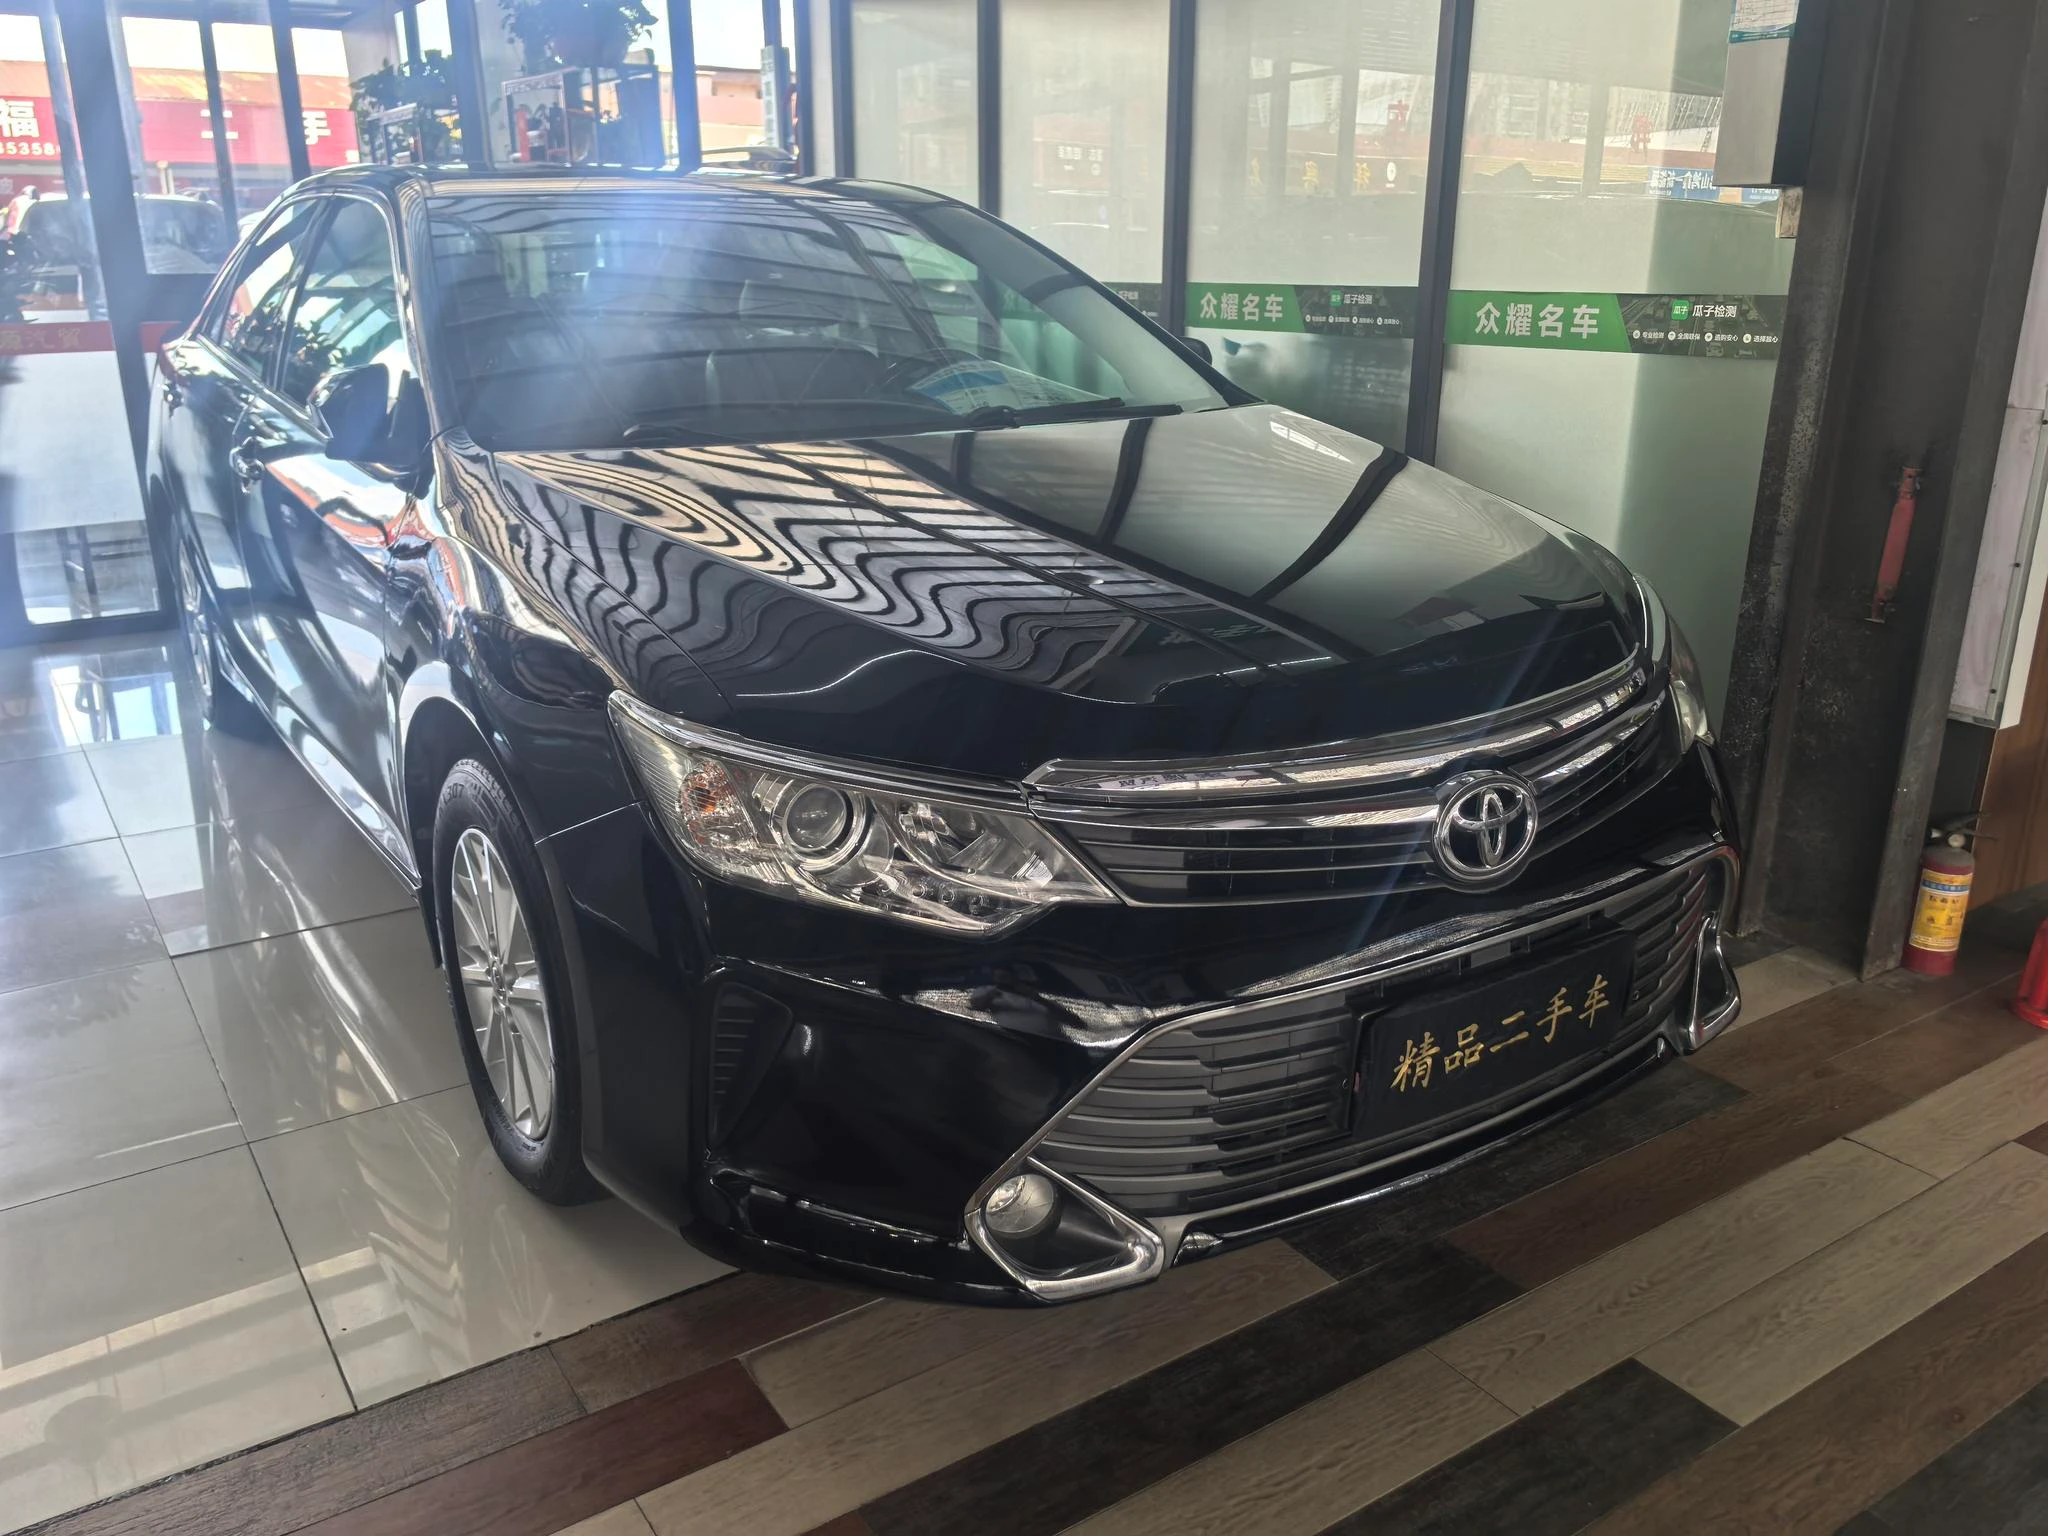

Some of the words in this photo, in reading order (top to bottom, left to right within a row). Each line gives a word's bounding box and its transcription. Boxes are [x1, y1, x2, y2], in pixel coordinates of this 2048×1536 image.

[0, 98, 40, 138] 福
[1200, 291, 1284, 322] 众耀名车
[1474, 301, 1600, 339] 众耀名车
[1673, 305, 1689, 315] 瓜子
[1692, 304, 1737, 318] 瓜子检测
[1390, 974, 1609, 1092] 精品二手车
